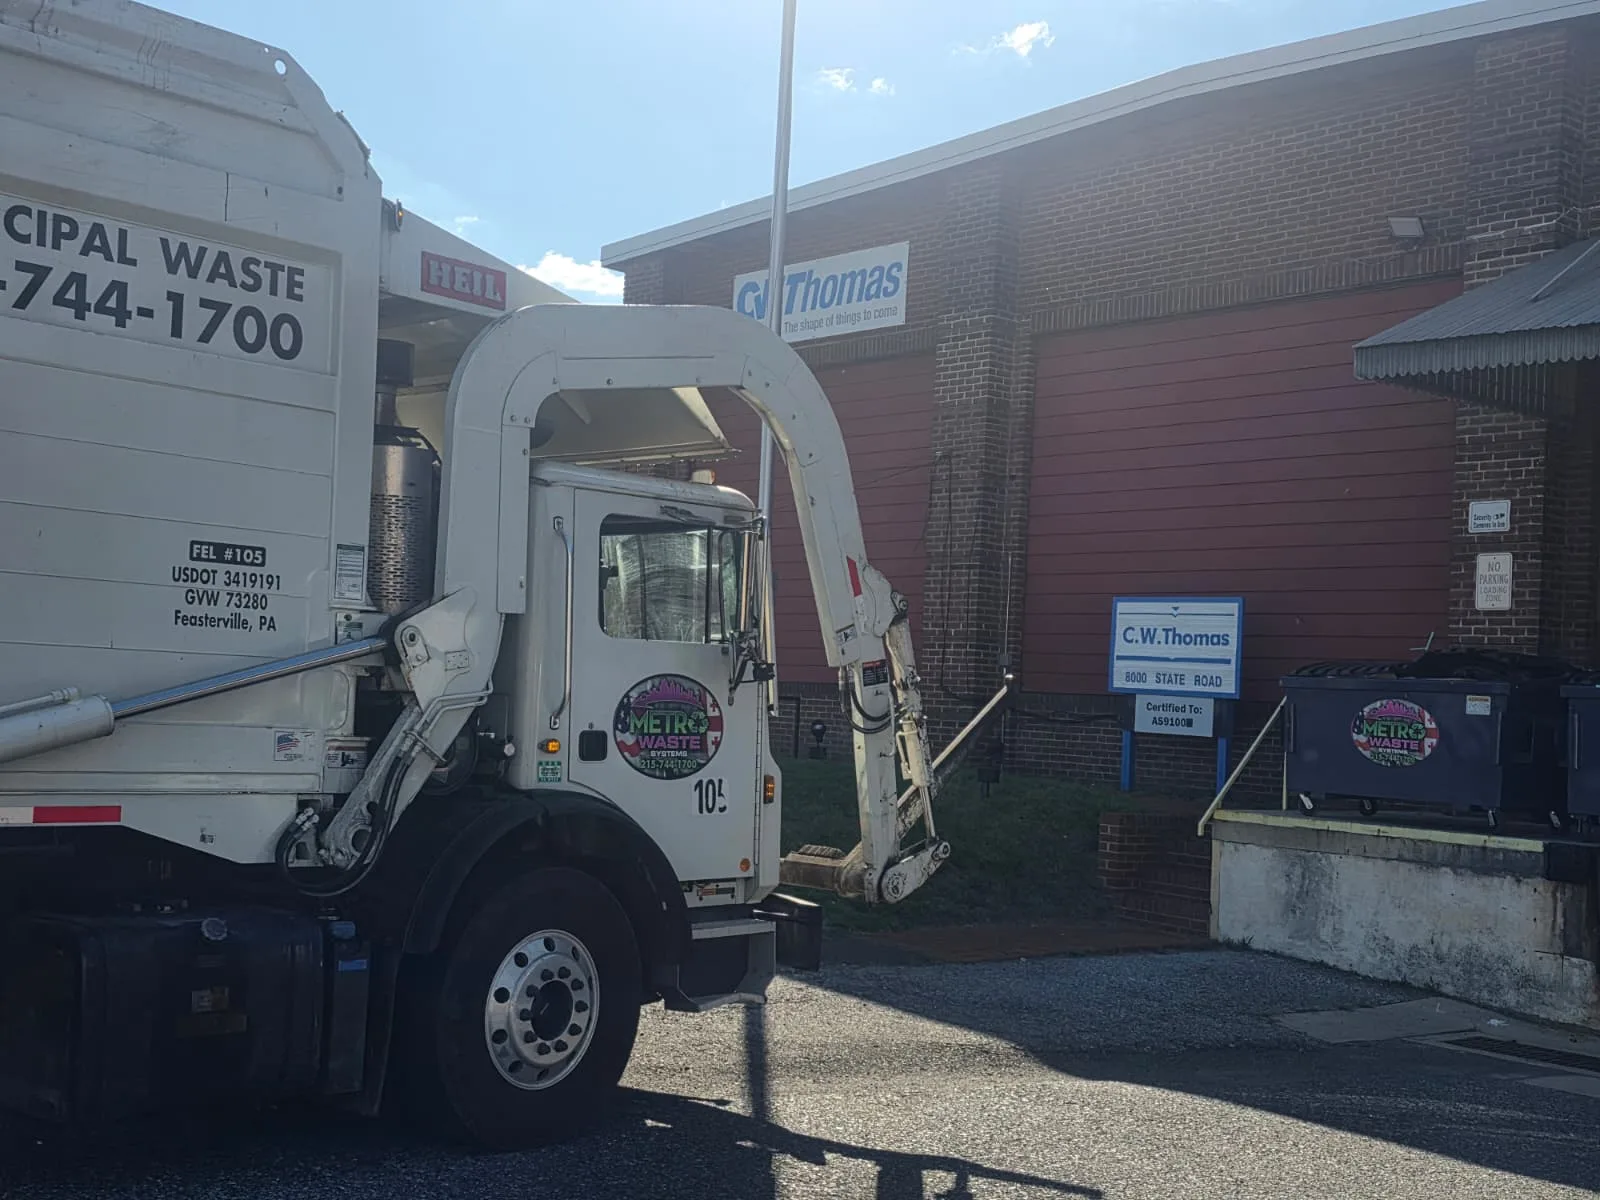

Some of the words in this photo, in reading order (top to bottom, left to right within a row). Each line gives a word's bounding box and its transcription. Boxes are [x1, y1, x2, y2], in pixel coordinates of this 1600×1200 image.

[3, 204, 138, 268] CIPAL
[159, 236, 305, 302] WASTE
[428, 260, 502, 302] HEIL
[784, 262, 903, 315] Thomas
[784, 321, 798, 334] The
[800, 316, 824, 332] shape
[826, 315, 834, 327] of
[836, 309, 862, 326] things
[863, 308, 872, 320] to
[874, 306, 898, 320] come
[192, 544, 217, 560] FEL
[224, 546, 263, 565] #105
[1487, 561, 1501, 573] NO
[172, 565, 218, 586] USDOT
[223, 569, 281, 591] 3419191
[1479, 573, 1509, 585] PARKING
[185, 588, 220, 607] GVW
[225, 591, 268, 611] 73280
[1479, 585, 1508, 595] LOADING
[174, 609, 253, 633] Feasterville,
[259, 615, 277, 632] PA
[1125, 671, 1147, 684] 8000
[1155, 672, 1186, 686] STATE
[1194, 674, 1223, 688] ROAD
[1146, 702, 1187, 713] Certified
[1189, 704, 1203, 715] To:
[629, 709, 709, 735] METRO
[1362, 719, 1426, 740] METRO
[638, 735, 701, 750] WASTE
[1368, 736, 1420, 751] WASTE
[640, 759, 698, 769] 215-744-1700
[693, 778, 728, 815] 105
